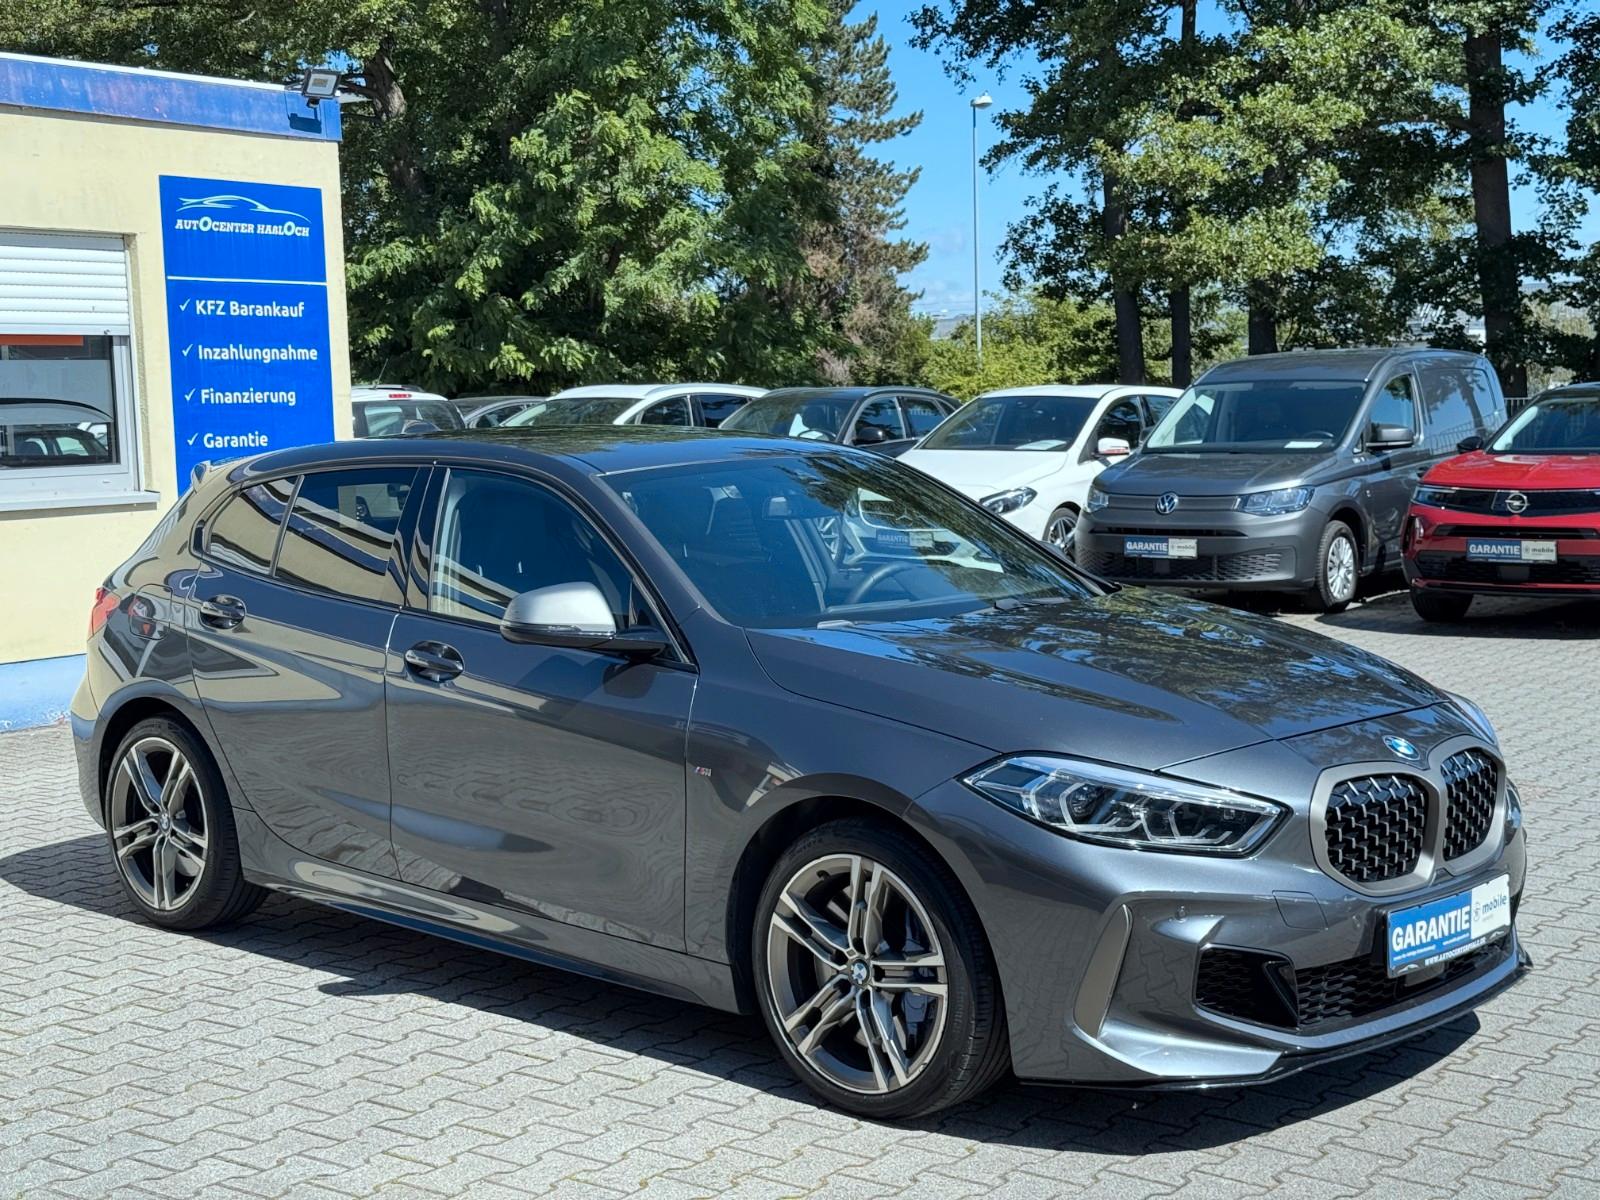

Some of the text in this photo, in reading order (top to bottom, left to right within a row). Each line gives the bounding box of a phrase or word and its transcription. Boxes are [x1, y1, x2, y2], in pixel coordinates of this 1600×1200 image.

[175, 216, 254, 234] AUTOCENTER
[195, 299, 305, 318] KFZ Barankauf
[198, 343, 318, 363] Inzahlungnahme
[200, 387, 296, 406] Finanzierung
[203, 431, 268, 448] Garantie
[1126, 541, 1168, 552] GARANTIE
[1469, 544, 1520, 555] GARANTIE
[1482, 893, 1507, 913] mobile
[1391, 905, 1471, 952] GARANTIE
